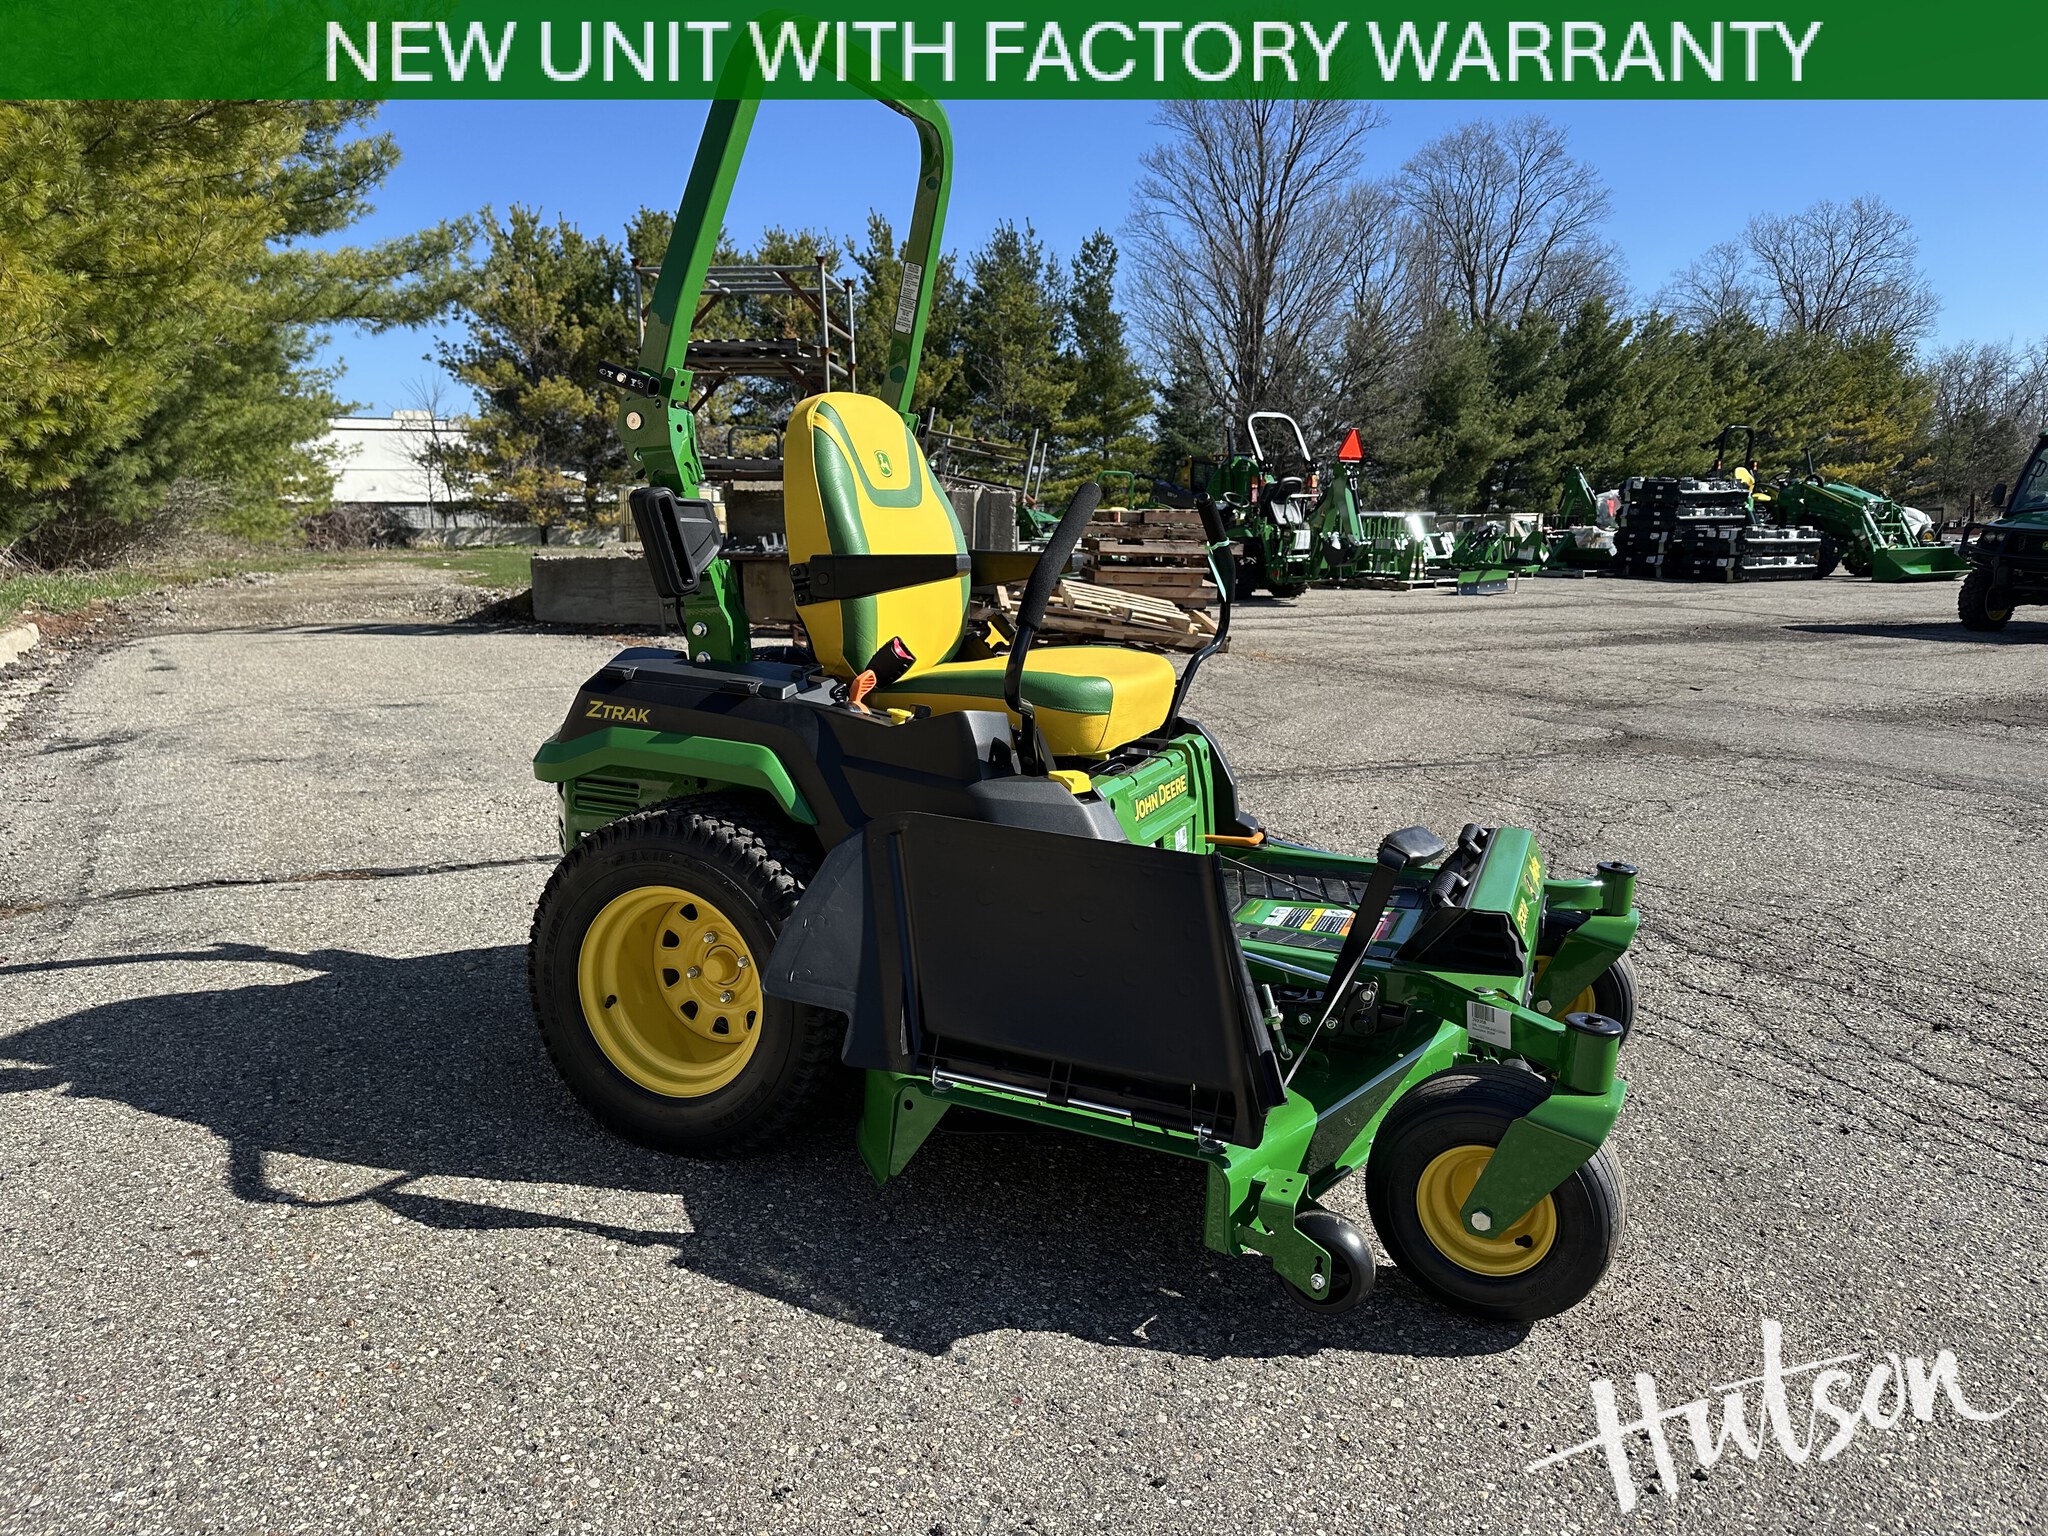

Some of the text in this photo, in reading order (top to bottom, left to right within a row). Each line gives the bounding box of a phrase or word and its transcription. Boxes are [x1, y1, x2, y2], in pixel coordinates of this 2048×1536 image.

[586, 700, 651, 723] ZTRAK
[1135, 774, 1187, 822] JOHN DEERE
